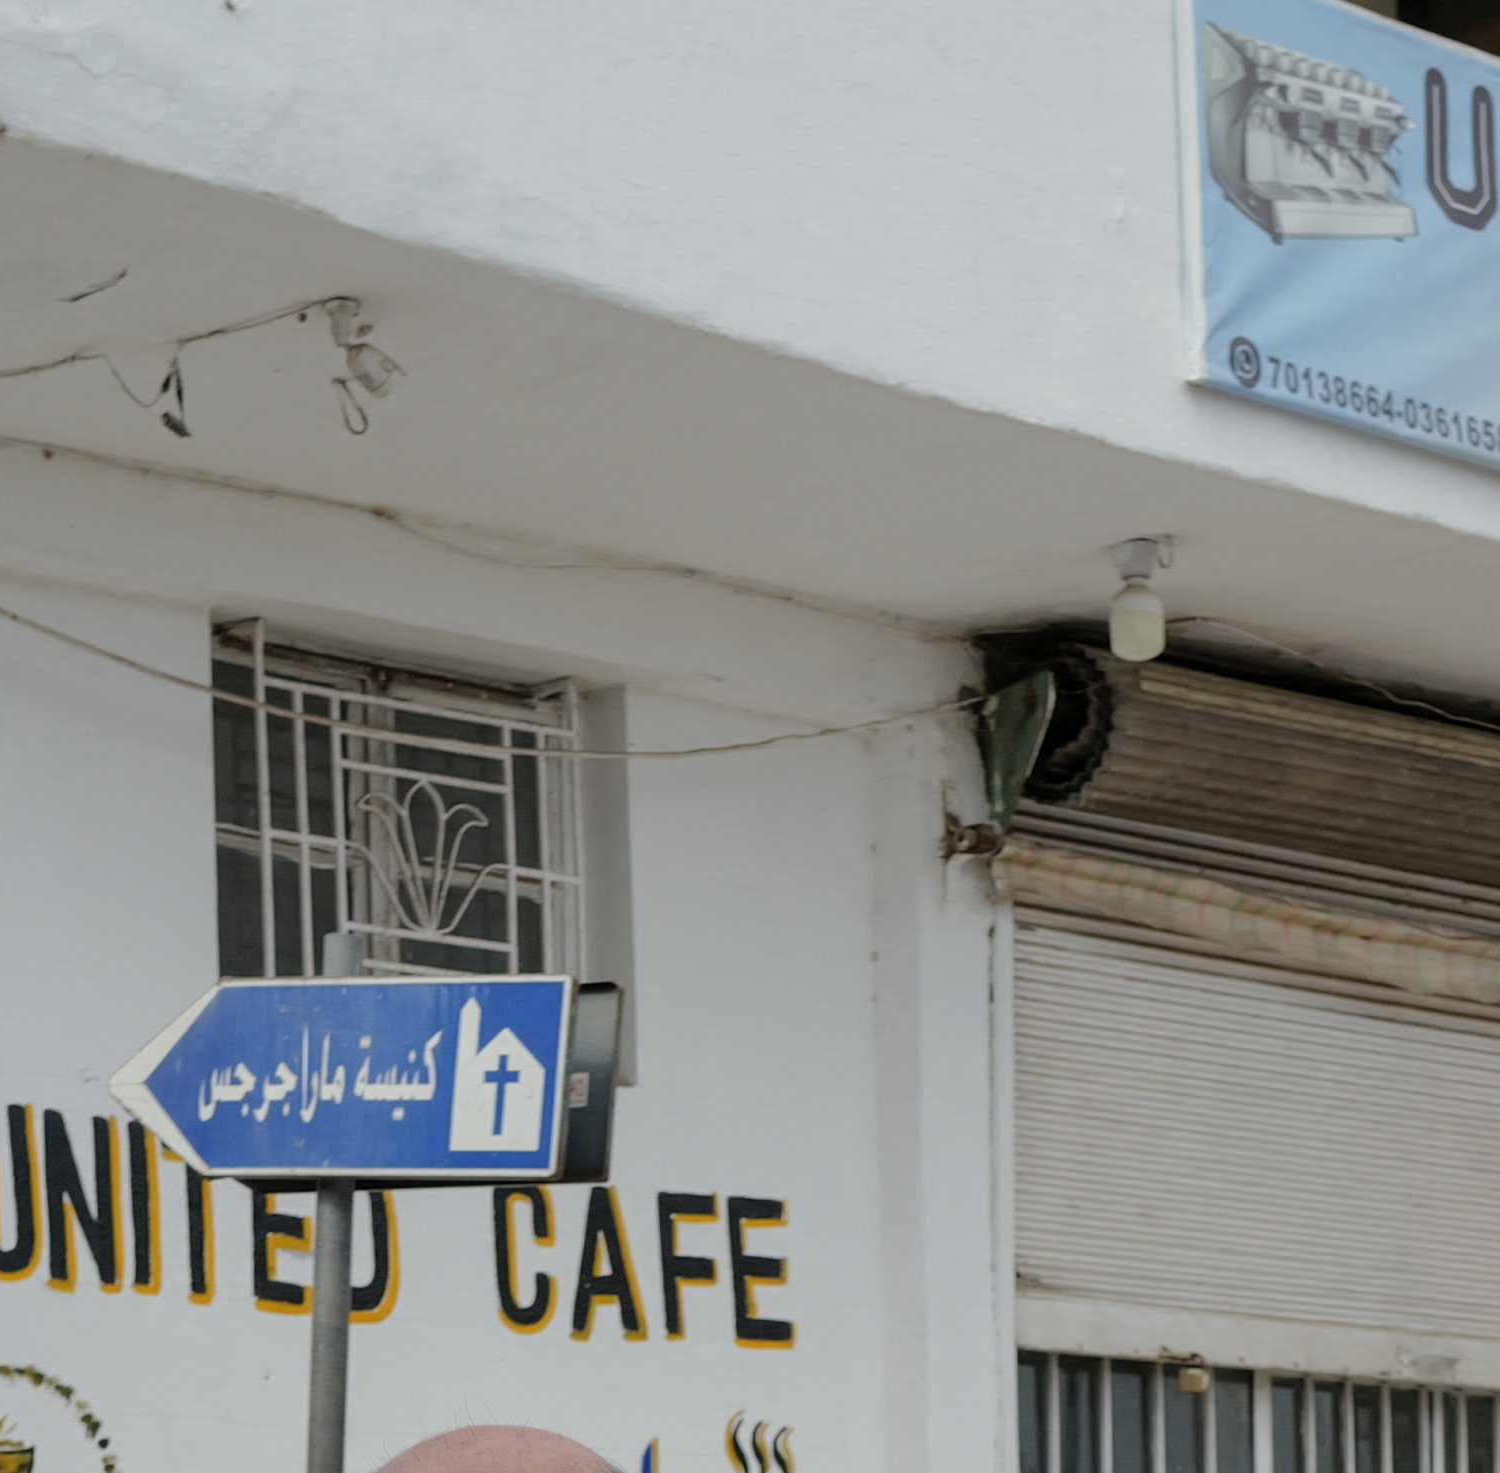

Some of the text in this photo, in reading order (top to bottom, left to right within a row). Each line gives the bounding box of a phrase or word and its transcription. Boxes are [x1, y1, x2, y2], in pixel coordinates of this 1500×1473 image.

[197, 1061, 299, 1123] جرجس
[354, 1029, 443, 1122] كنيسة
[492, 1185, 796, 1349] CAFE
